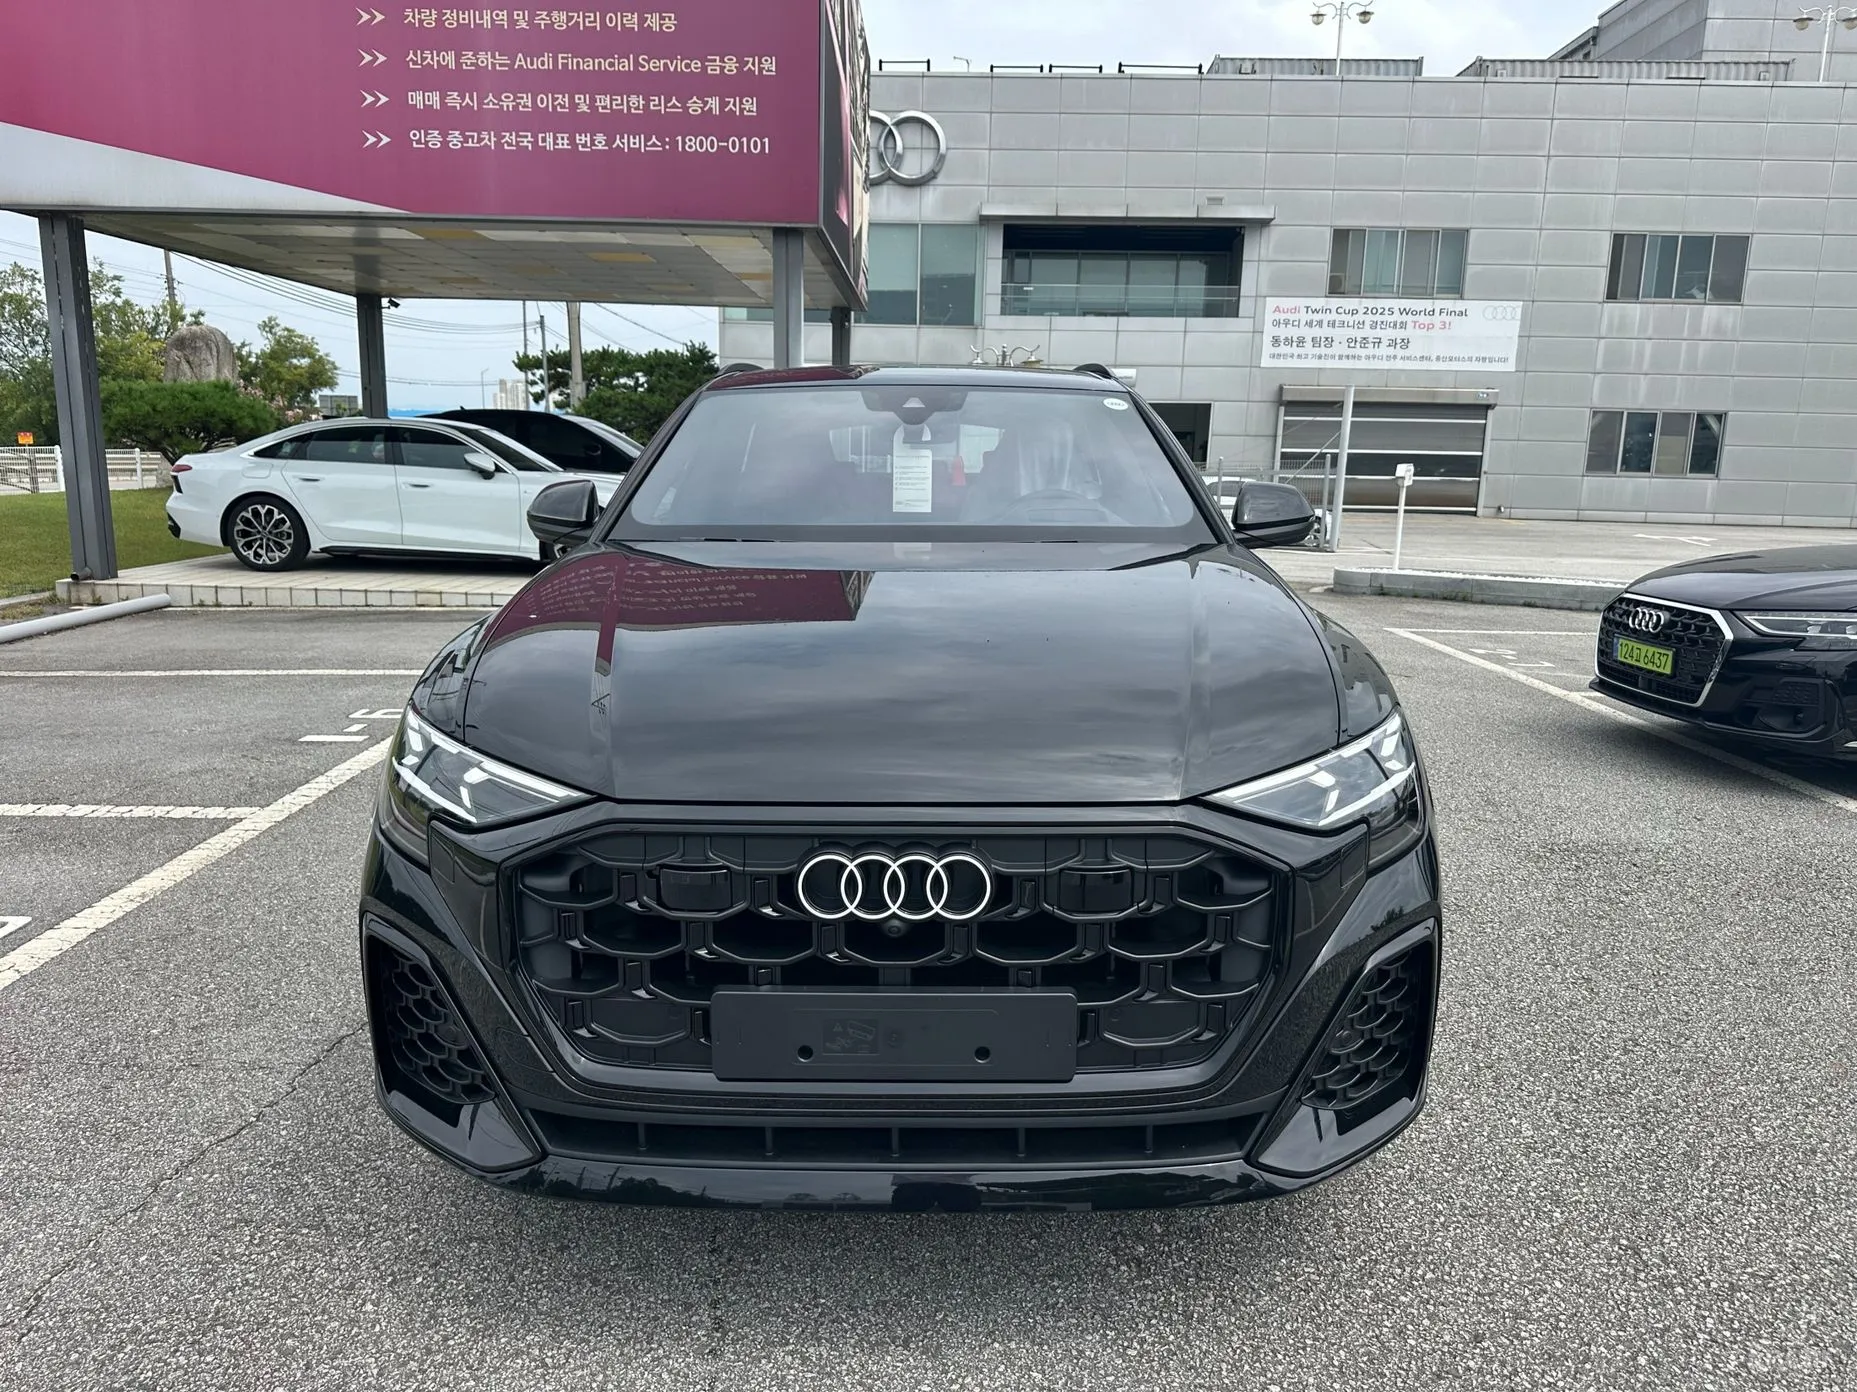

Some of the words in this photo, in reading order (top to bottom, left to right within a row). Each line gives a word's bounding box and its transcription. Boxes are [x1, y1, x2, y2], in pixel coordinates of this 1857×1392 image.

[404, 8, 438, 28] 차량
[441, 9, 508, 29] 정비내역
[513, 10, 530, 30] 및
[534, 10, 601, 31] 주행거리
[605, 12, 638, 32] 이력
[643, 12, 678, 32] 제공
[405, 50, 455, 70] 신차에
[459, 51, 511, 71] 준하는
[514, 53, 553, 70] Audi
[558, 53, 634, 72] Financial
[638, 55, 702, 73] Service
[705, 55, 740, 75] 금융
[743, 56, 777, 76] 지원
[407, 90, 441, 110] 매매
[444, 91, 478, 111] 즉시
[482, 92, 532, 112] 소유권
[537, 93, 570, 112] 이전
[574, 94, 591, 113] 및
[595, 94, 645, 114] 편리한
[649, 95, 683, 115] 리스
[686, 96, 720, 115] 승계
[724, 96, 758, 116] 지원
[409, 130, 443, 149] 인증
[446, 130, 497, 150] 중고차
[501, 131, 534, 151] 전국
[538, 132, 572, 151] 대표
[575, 132, 609, 152] 번호
[675, 135, 770, 154] 1800-0101
[1272, 305, 1300, 315] Audi
[1304, 305, 1332, 315] Twin
[1336, 306, 1359, 317] Cup
[1362, 306, 1395, 316] 2025
[1399, 307, 1436, 317] World
[1439, 308, 1468, 317] Final
[1272, 318, 1301, 329] 아우디
[1304, 319, 1323, 329] 세계
[1327, 319, 1365, 330] 테크니션
[1369, 319, 1408, 330] 경진대회
[1411, 320, 1435, 331] Top
[1439, 321, 1452, 330] 3!
[1270, 335, 1307, 348] 동하윤
[1311, 336, 1334, 349] 팀장
[1346, 336, 1383, 350] 안준규
[1386, 337, 1411, 350] 과장
[1643, 648, 1669, 670] 6437
